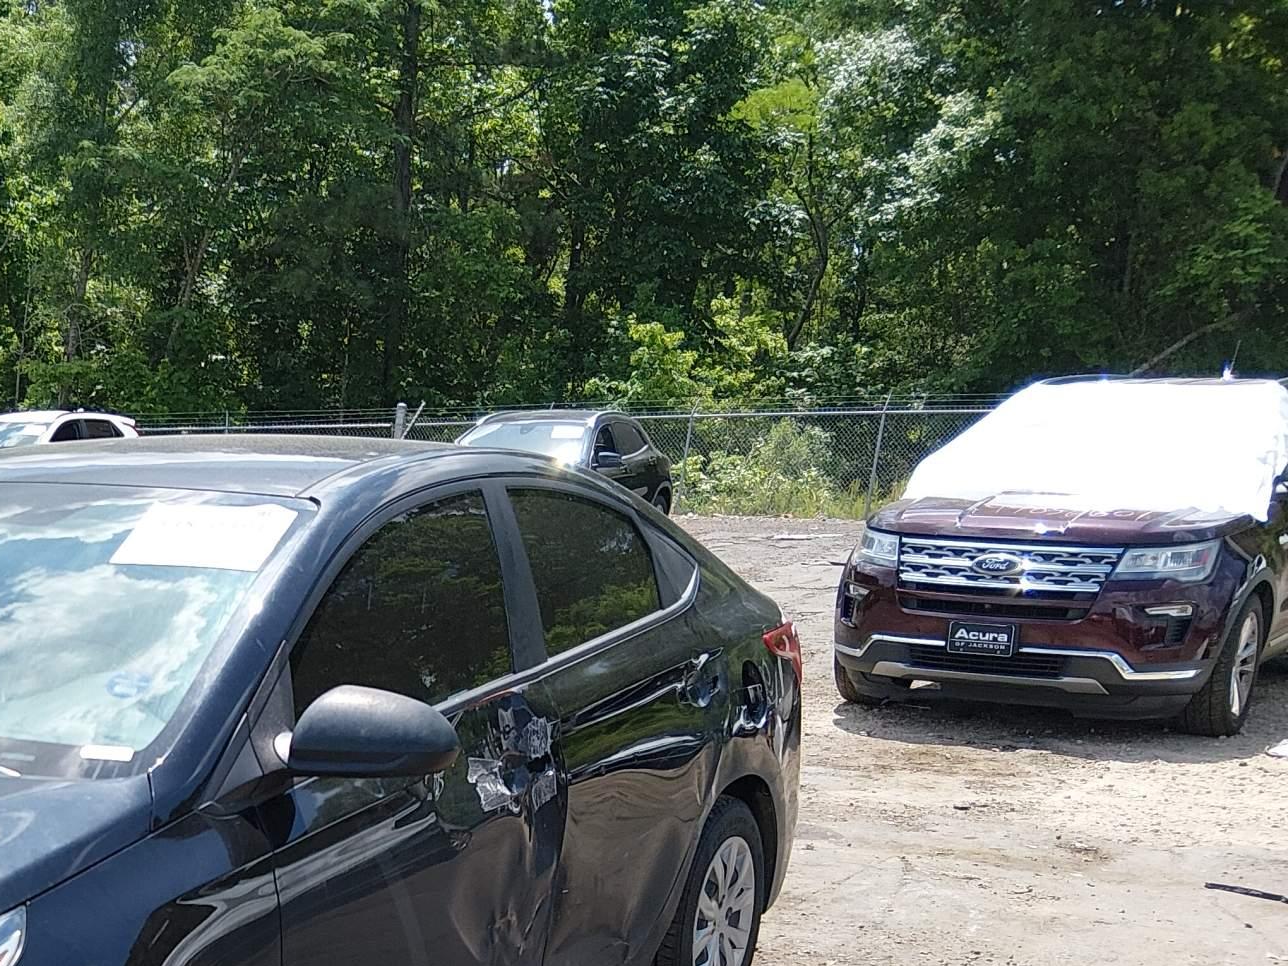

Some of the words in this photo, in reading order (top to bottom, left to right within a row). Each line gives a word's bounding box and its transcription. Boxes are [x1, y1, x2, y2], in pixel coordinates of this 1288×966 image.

[982, 558, 1009, 570] Ford
[954, 628, 1008, 642] Acura
[968, 642, 1006, 650] JACKSON
